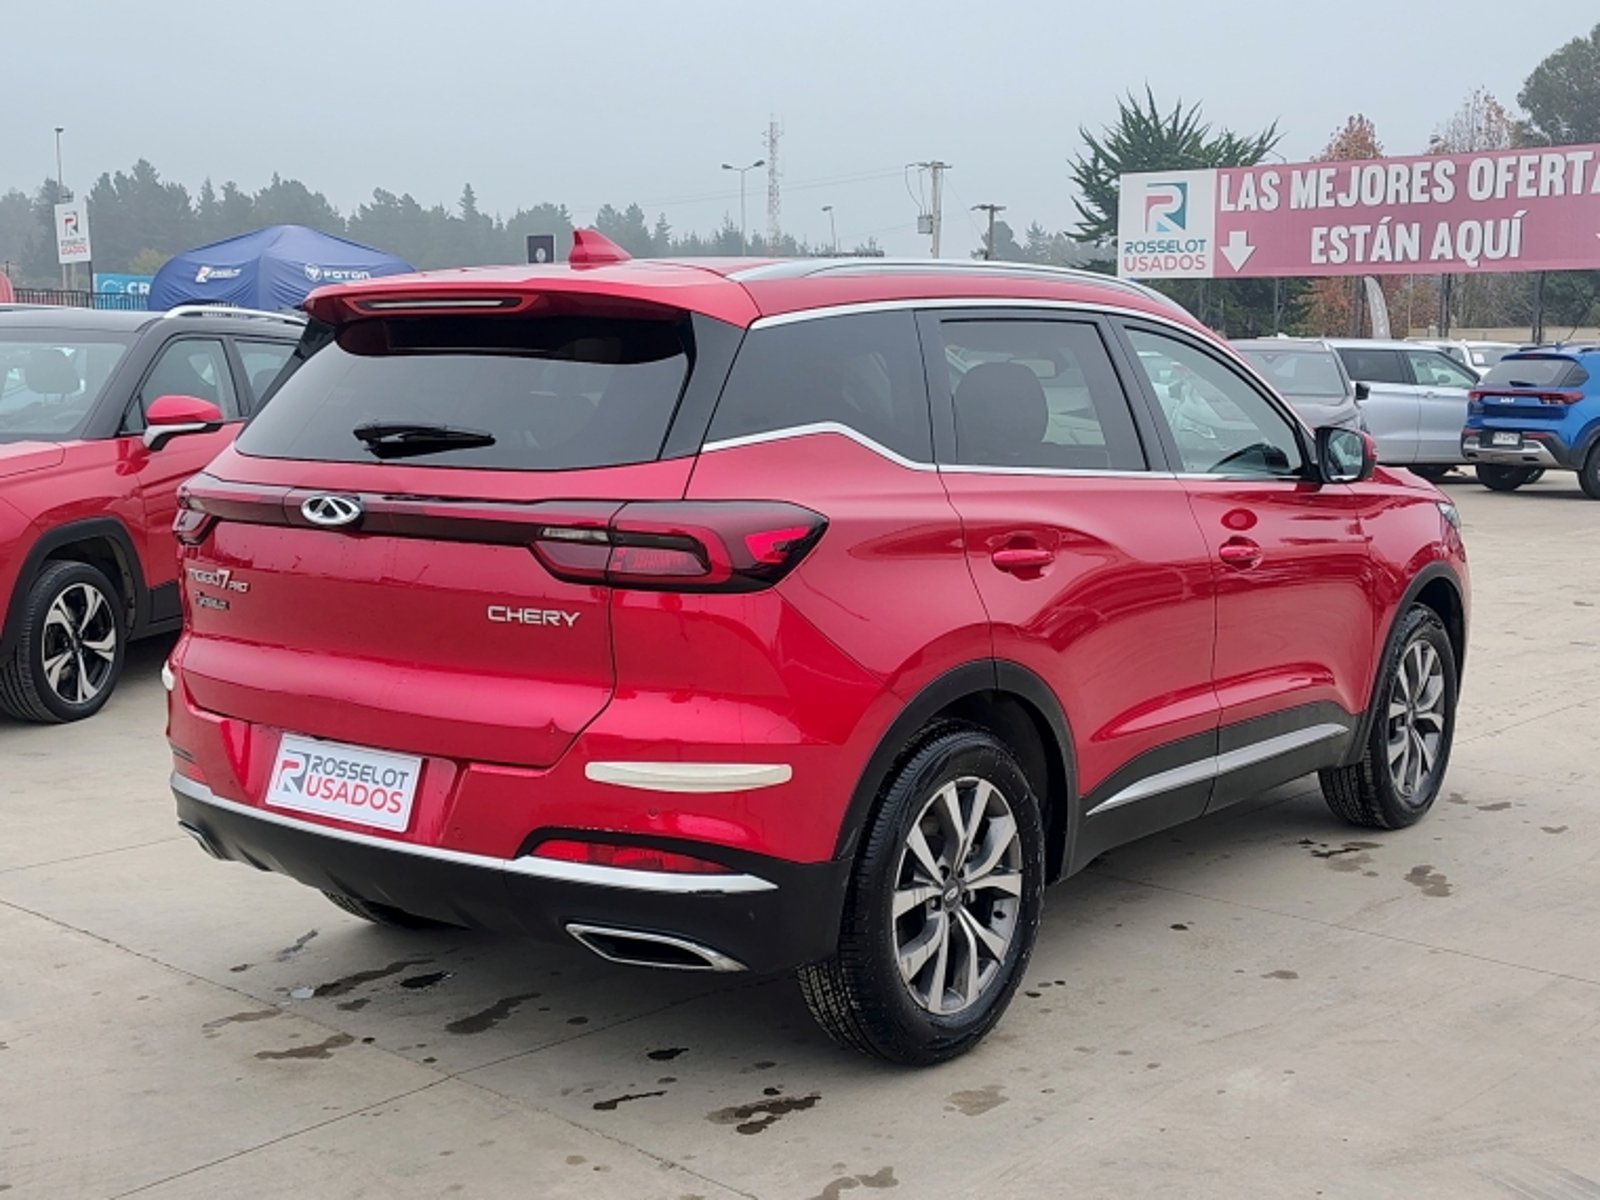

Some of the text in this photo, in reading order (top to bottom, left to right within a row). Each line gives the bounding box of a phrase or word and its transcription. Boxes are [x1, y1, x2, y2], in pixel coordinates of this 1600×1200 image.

[1220, 170, 1280, 212] LAS
[1290, 160, 1456, 209] MEJORES
[1124, 239, 1207, 254] ROSSELOT
[1311, 210, 1528, 267] ESTÁN AQUÍ
[1124, 254, 1206, 272] USADOS
[488, 605, 580, 627] CHERY
[311, 756, 409, 789] ROSSELOT
[306, 775, 404, 814] USADOS
